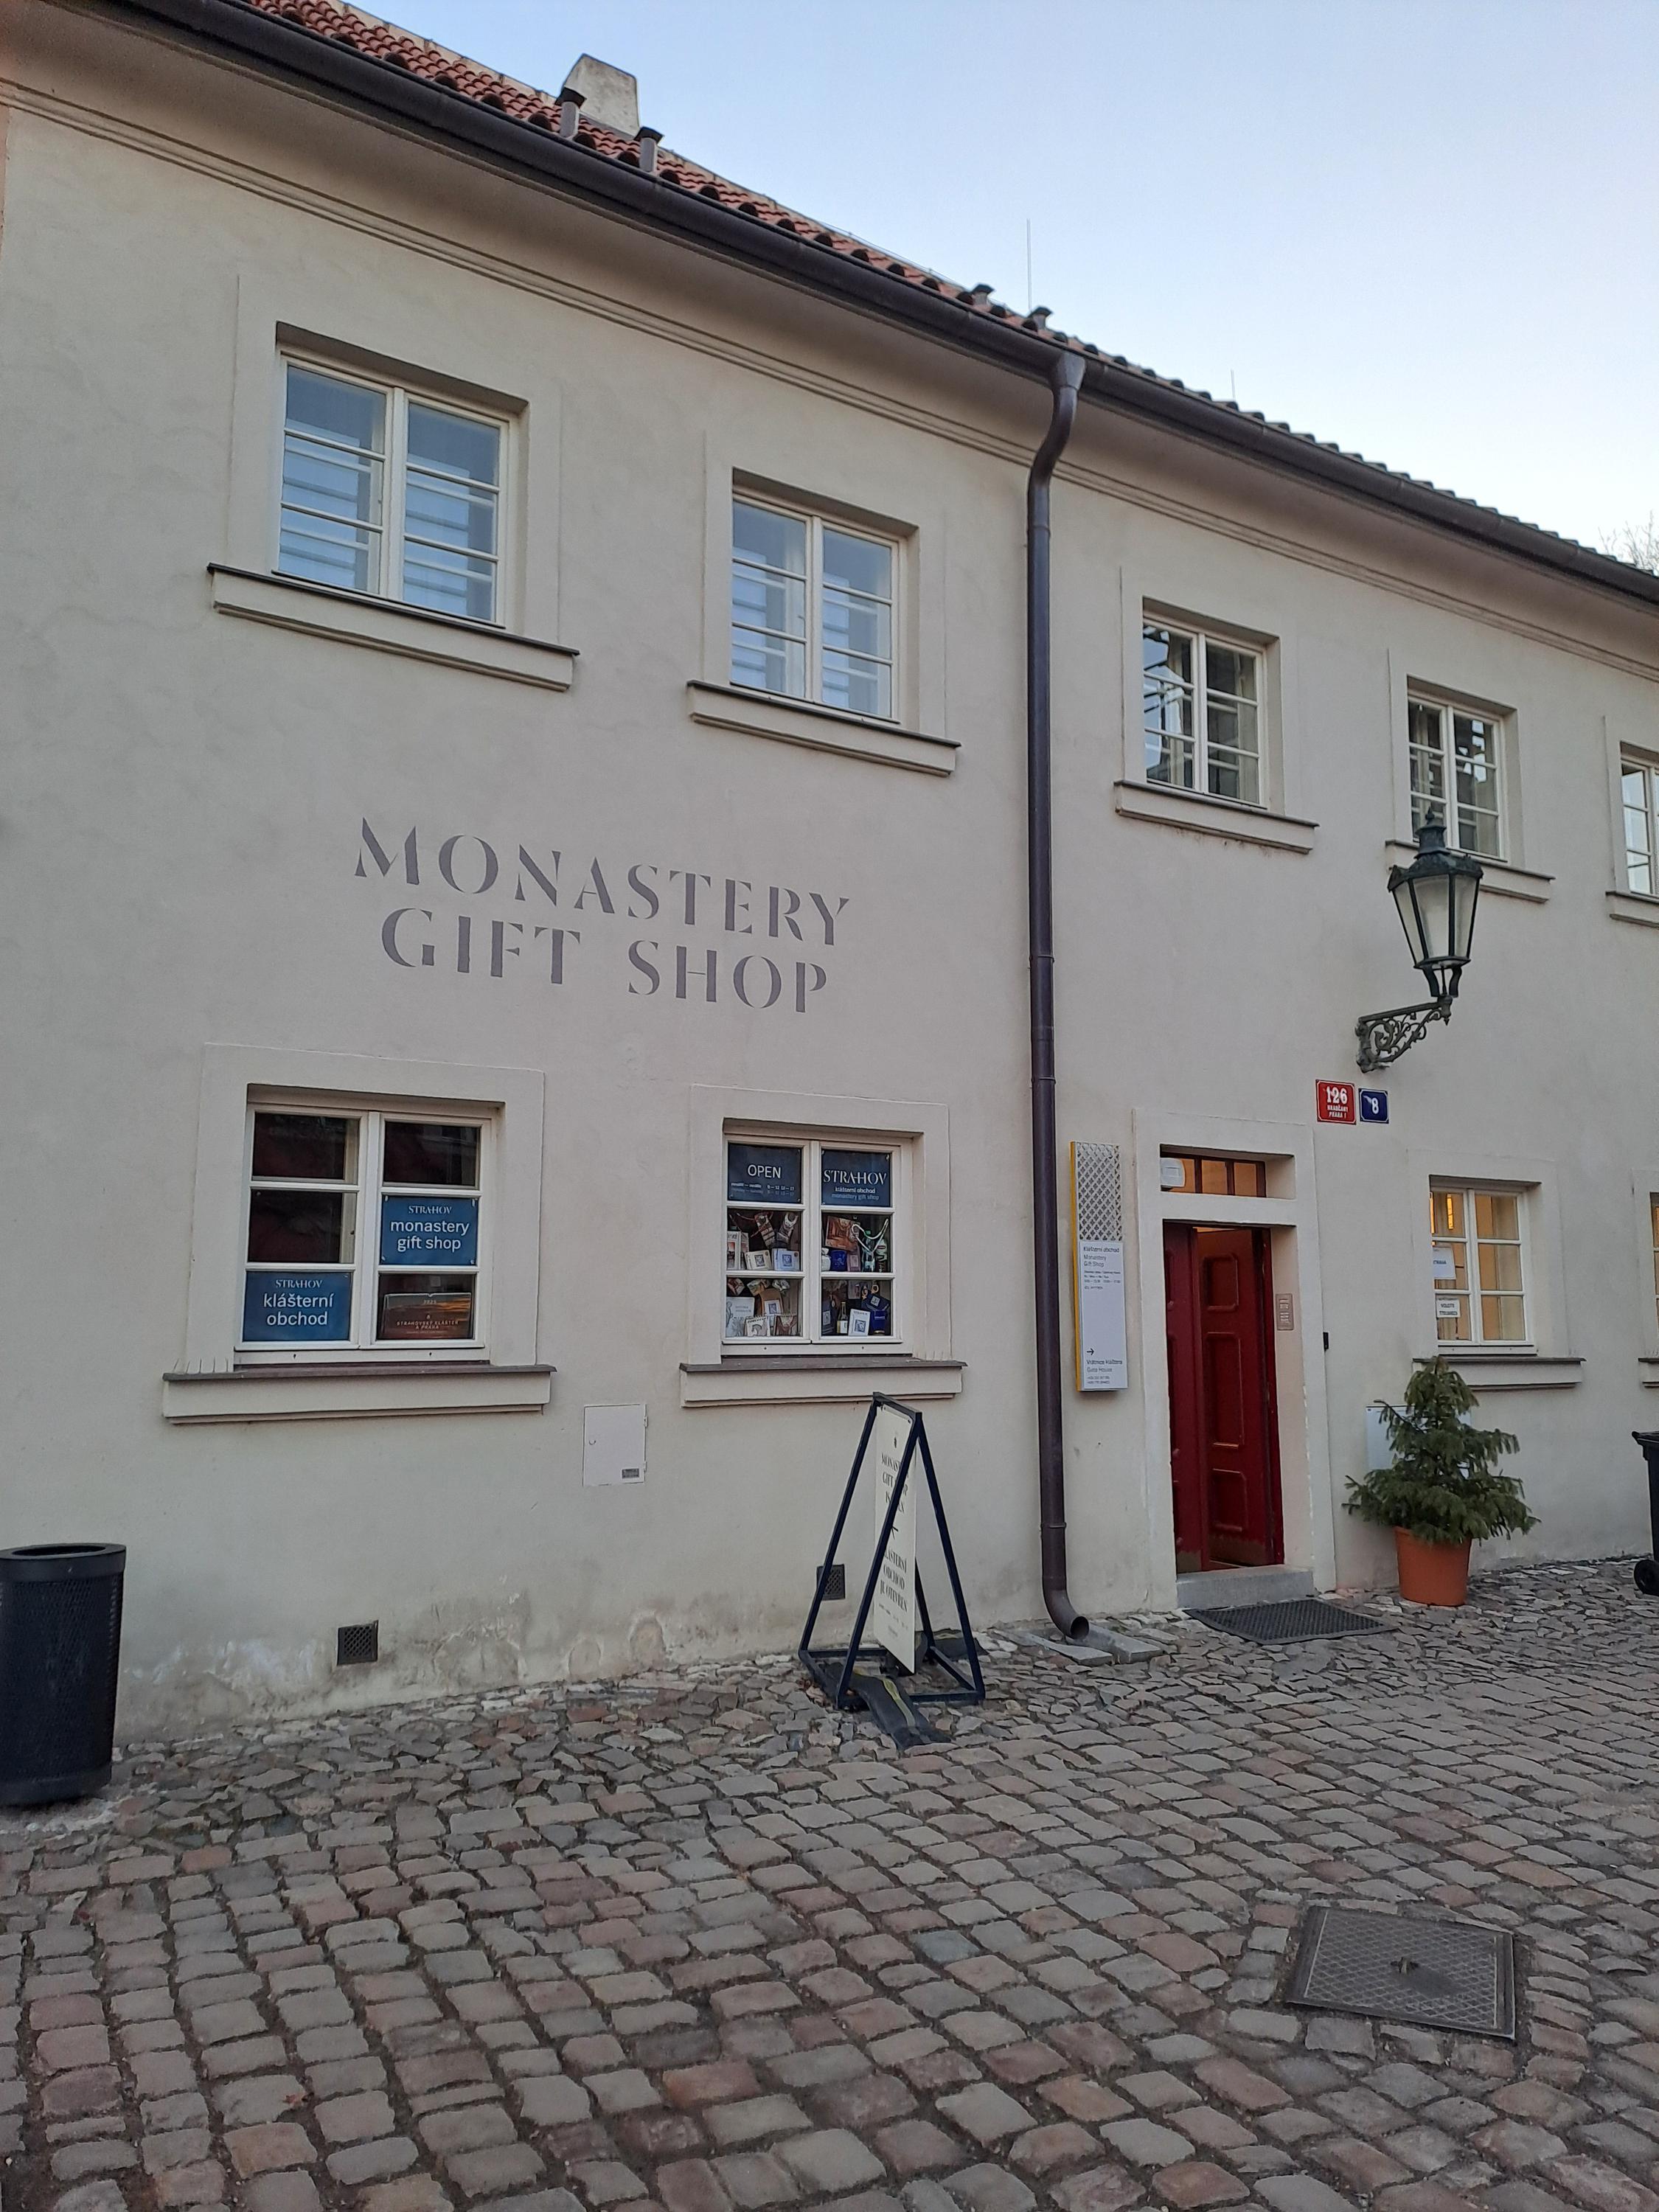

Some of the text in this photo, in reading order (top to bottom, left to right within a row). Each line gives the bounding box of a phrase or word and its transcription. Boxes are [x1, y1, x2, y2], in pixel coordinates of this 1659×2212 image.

[354, 817, 849, 946] MONASTERY
[381, 908, 827, 1013] GIFT SHOP
[1326, 1086, 1347, 1104] 126
[1371, 1098, 1379, 1114] 8
[748, 1165, 781, 1178] OPEN
[823, 1169, 886, 1185] STRAHOV
[408, 1206, 452, 1214] STRAHOV
[390, 1220, 470, 1236] monastery
[397, 1236, 461, 1253] gift shop
[276, 1279, 322, 1288] STRAHOV
[263, 1293, 335, 1307] klášterní
[267, 1311, 327, 1326] obchod
